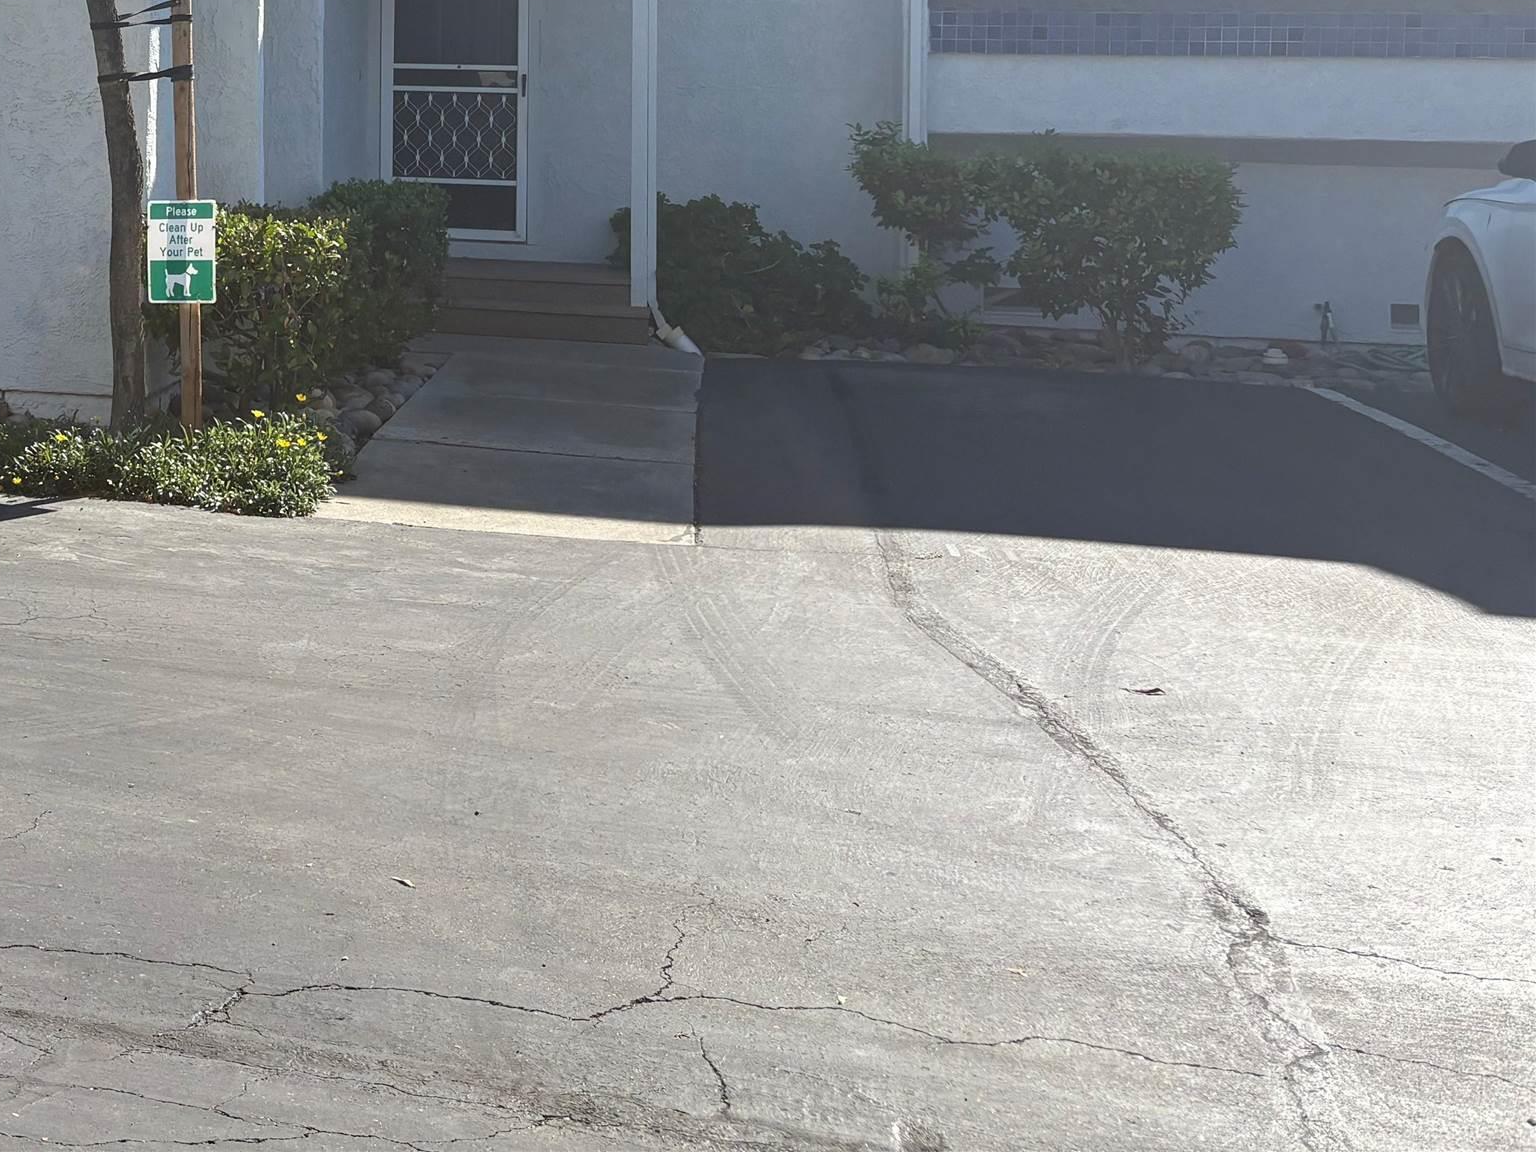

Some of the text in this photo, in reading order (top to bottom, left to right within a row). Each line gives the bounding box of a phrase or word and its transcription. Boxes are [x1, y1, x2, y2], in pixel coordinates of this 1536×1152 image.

[165, 206, 197, 217] Please
[158, 222, 204, 234] Clean Up
[169, 235, 193, 245] After
[159, 247, 203, 257] Your Pet
